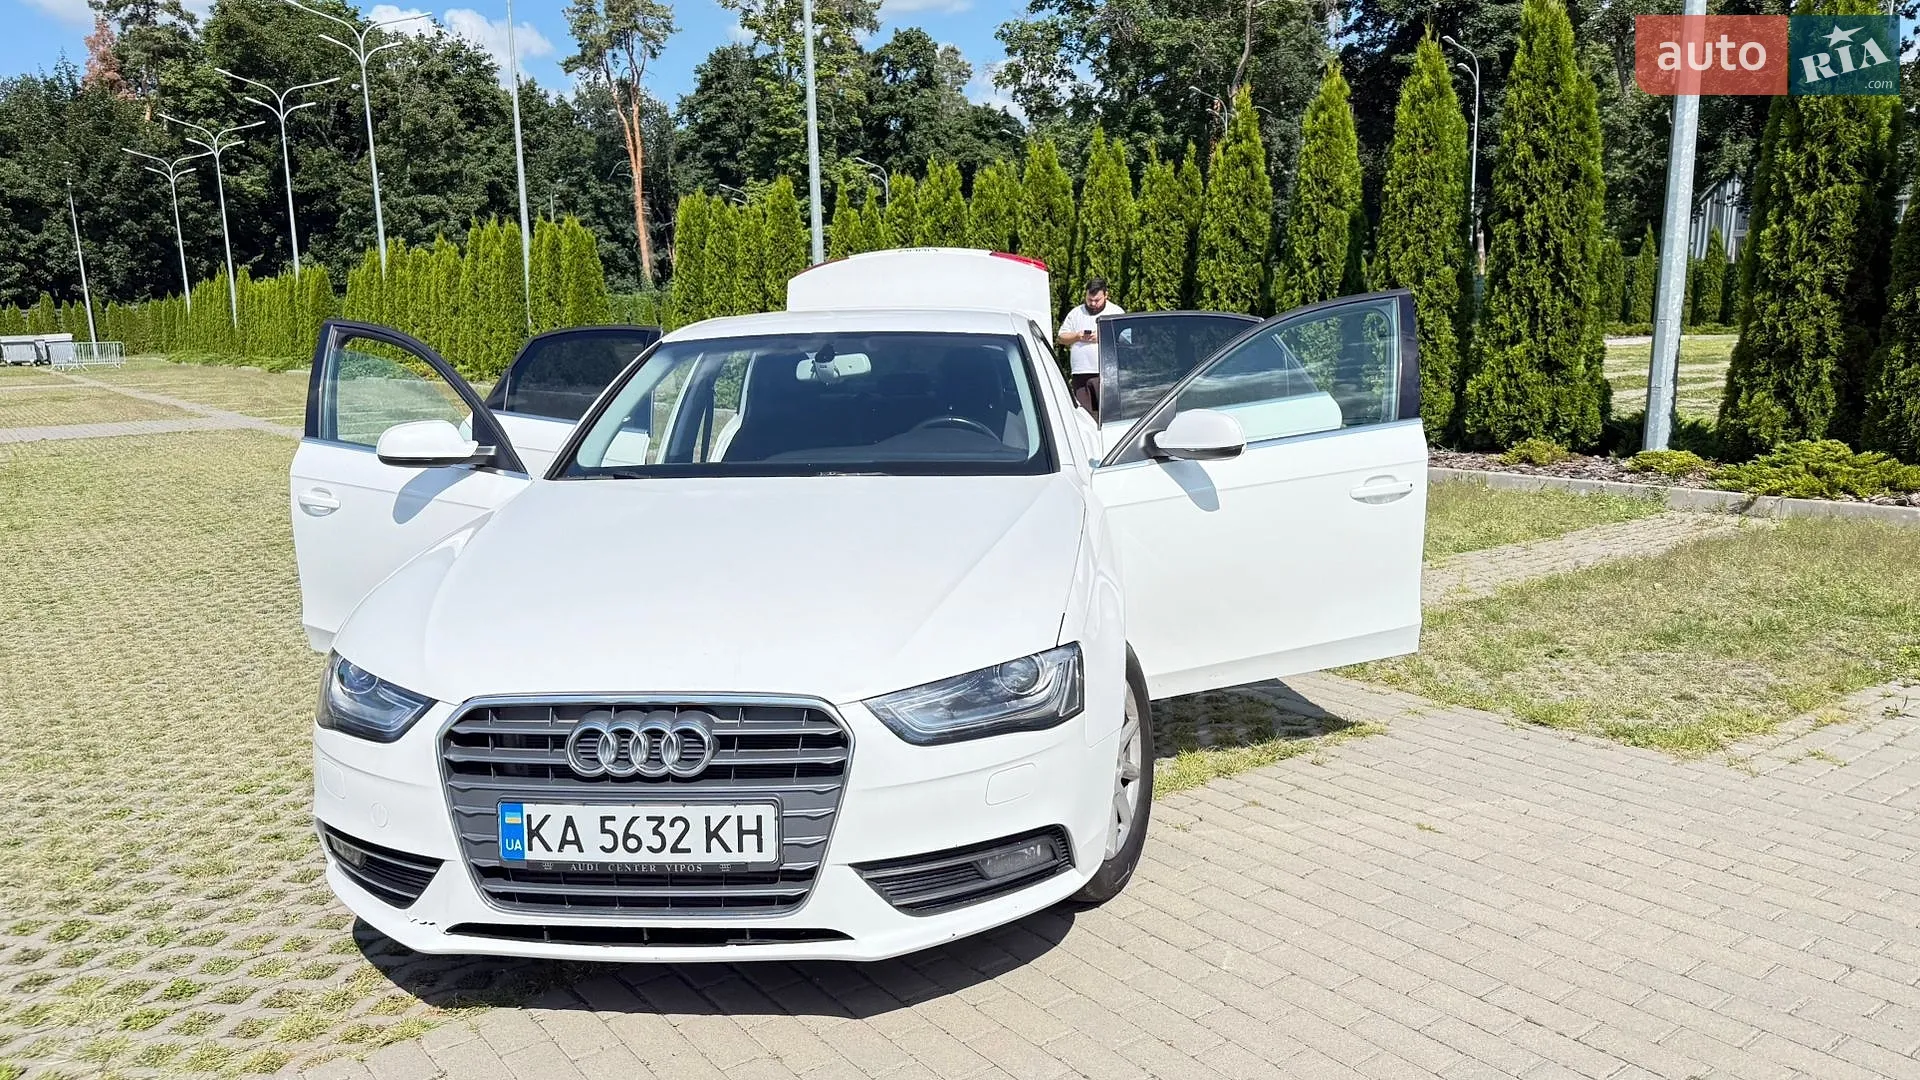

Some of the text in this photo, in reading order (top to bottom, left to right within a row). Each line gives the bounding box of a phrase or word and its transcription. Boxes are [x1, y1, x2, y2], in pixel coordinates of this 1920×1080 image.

[526, 814, 763, 854] KA 5632 KH
[505, 838, 522, 850] UA
[570, 863, 703, 872] AUDI CENTER VIPOS
